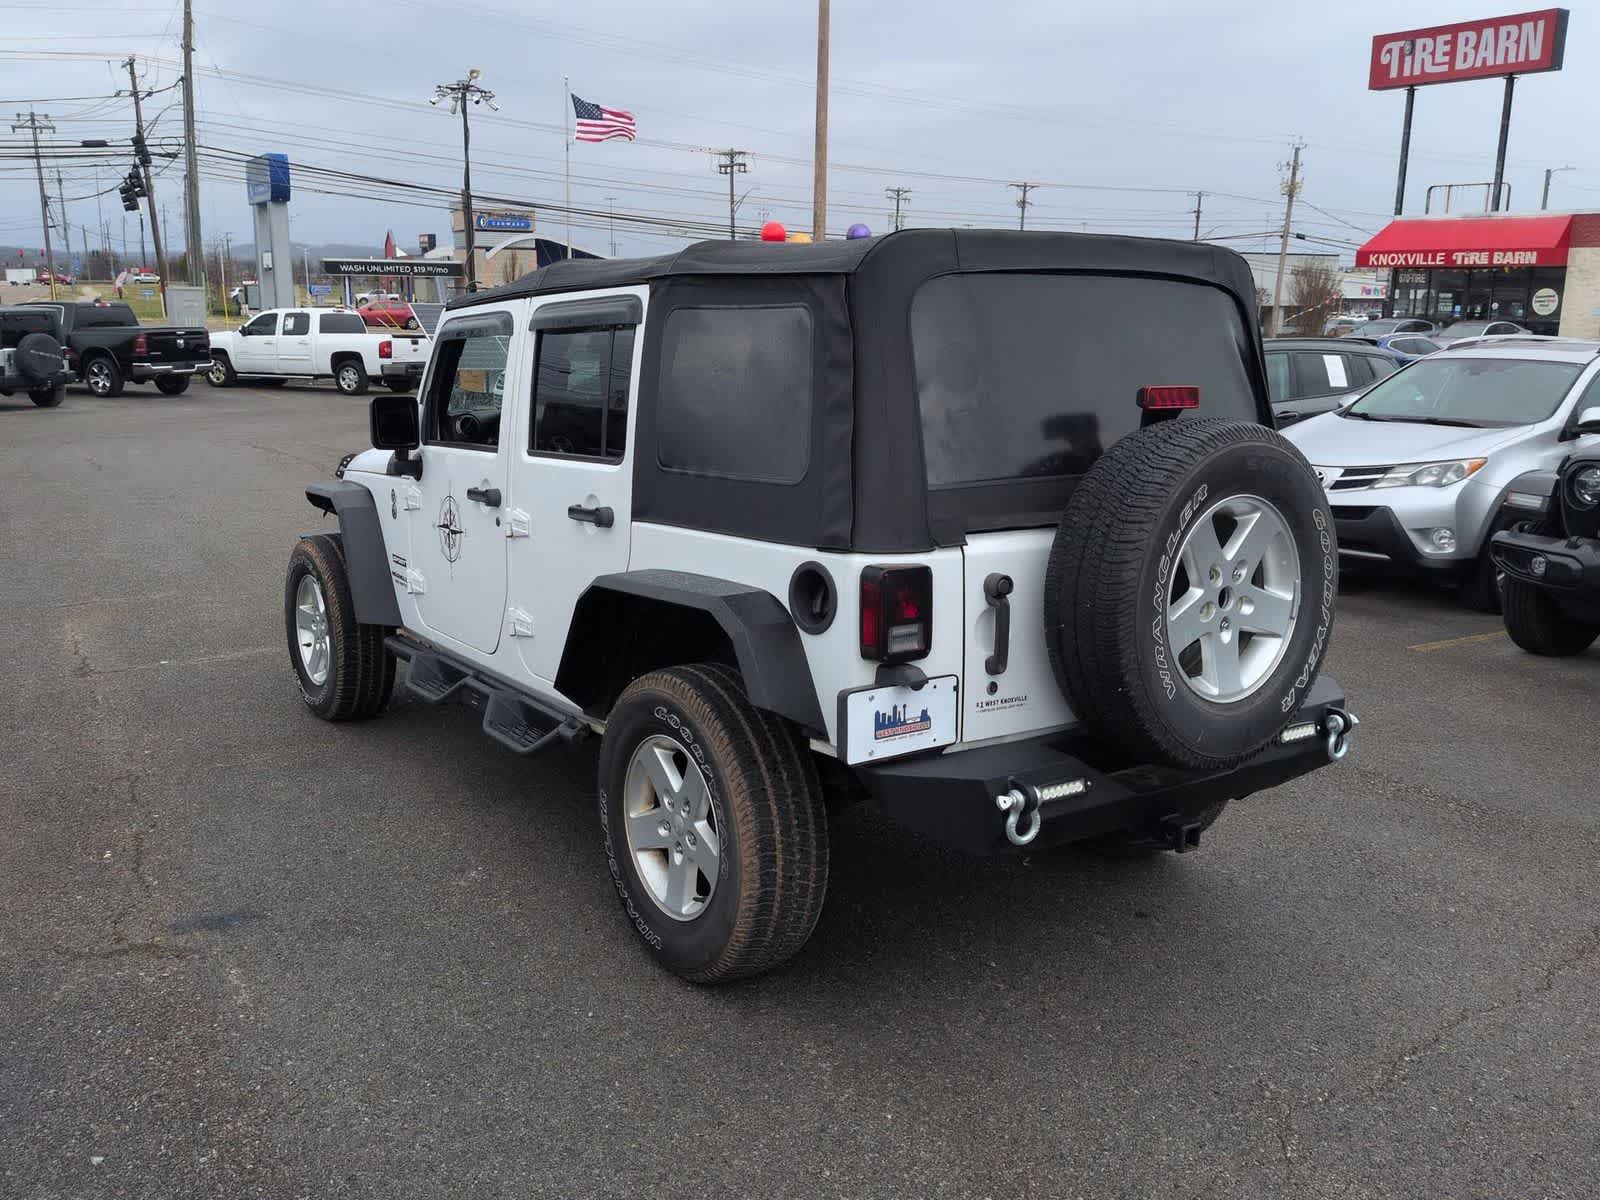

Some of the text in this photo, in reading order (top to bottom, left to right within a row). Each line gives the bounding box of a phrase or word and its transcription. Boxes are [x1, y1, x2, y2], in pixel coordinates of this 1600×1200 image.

[1455, 19, 1544, 70] BARN
[340, 264, 365, 272] WASH
[367, 264, 411, 273] UNLIMITED
[1369, 252, 1445, 266] KNOXVILLE
[1493, 251, 1537, 264] BARN
[1153, 484, 1209, 701] WRANGLER
[1281, 508, 1334, 713] GOODYEAR
